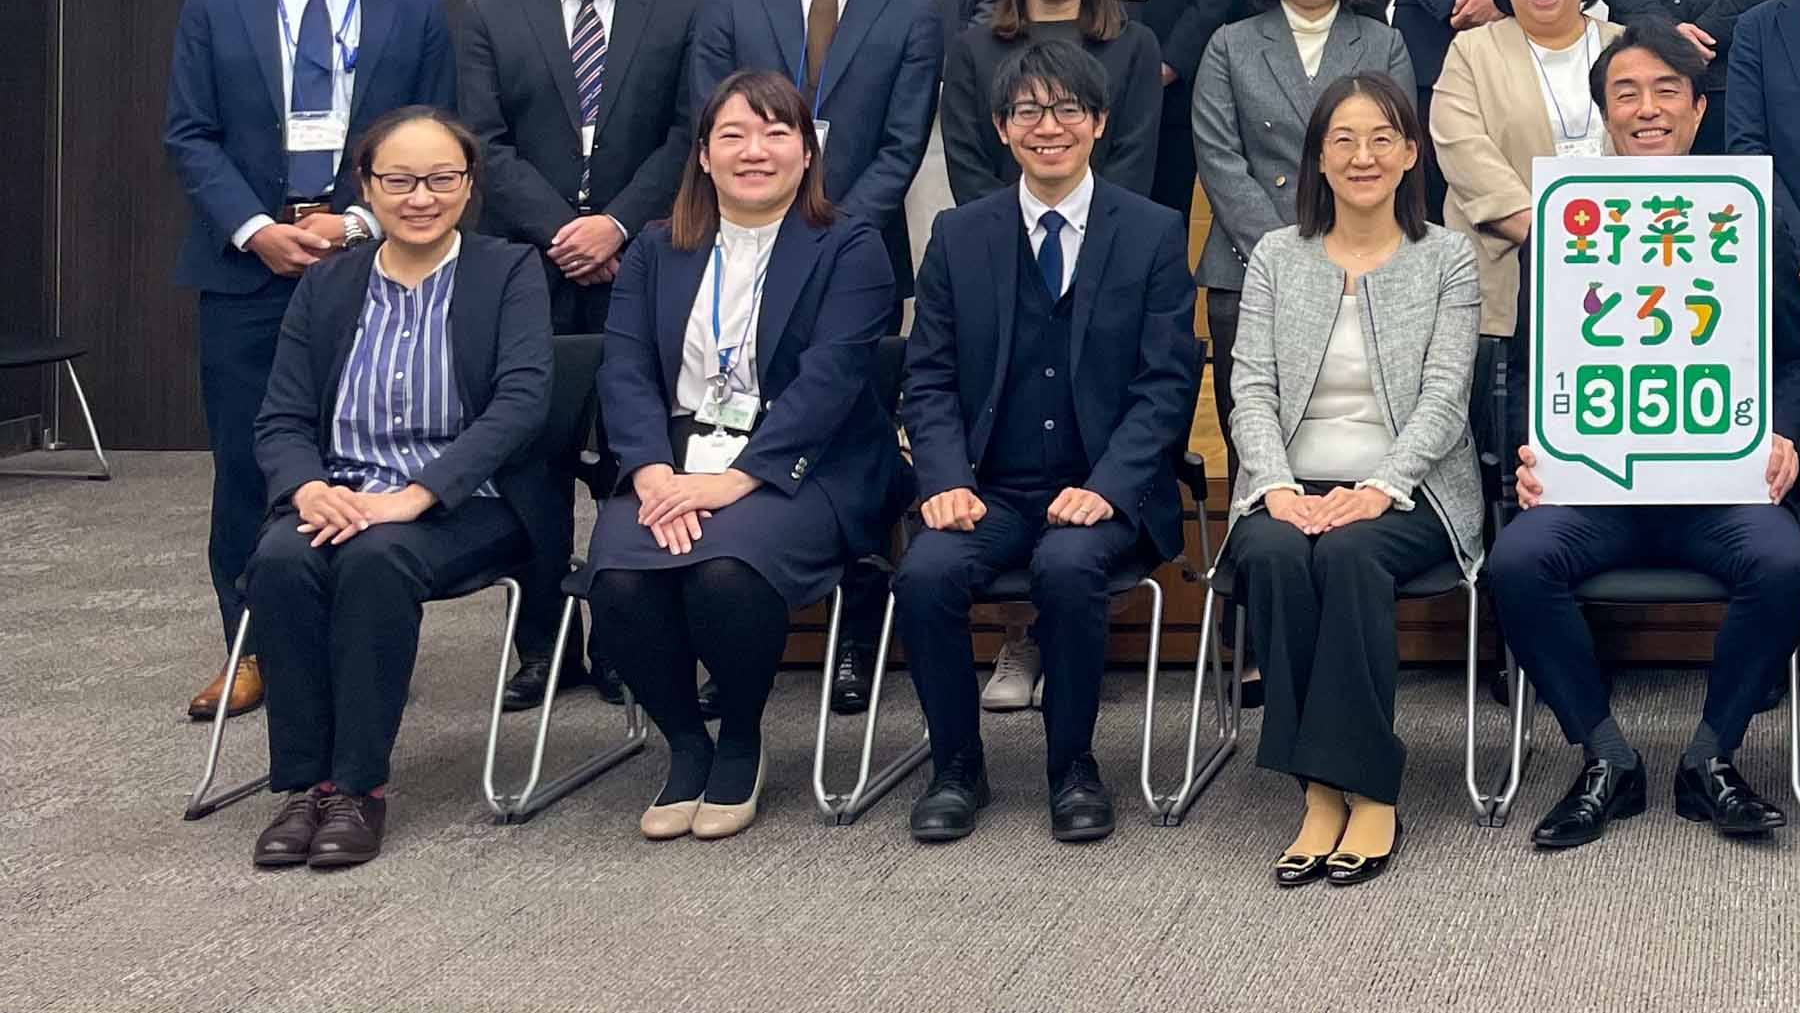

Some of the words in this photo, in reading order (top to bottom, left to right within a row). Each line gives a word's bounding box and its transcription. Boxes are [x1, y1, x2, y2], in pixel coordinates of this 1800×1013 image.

[1563, 195, 1742, 267] 野菜を
[1582, 278, 1722, 347] とろう
